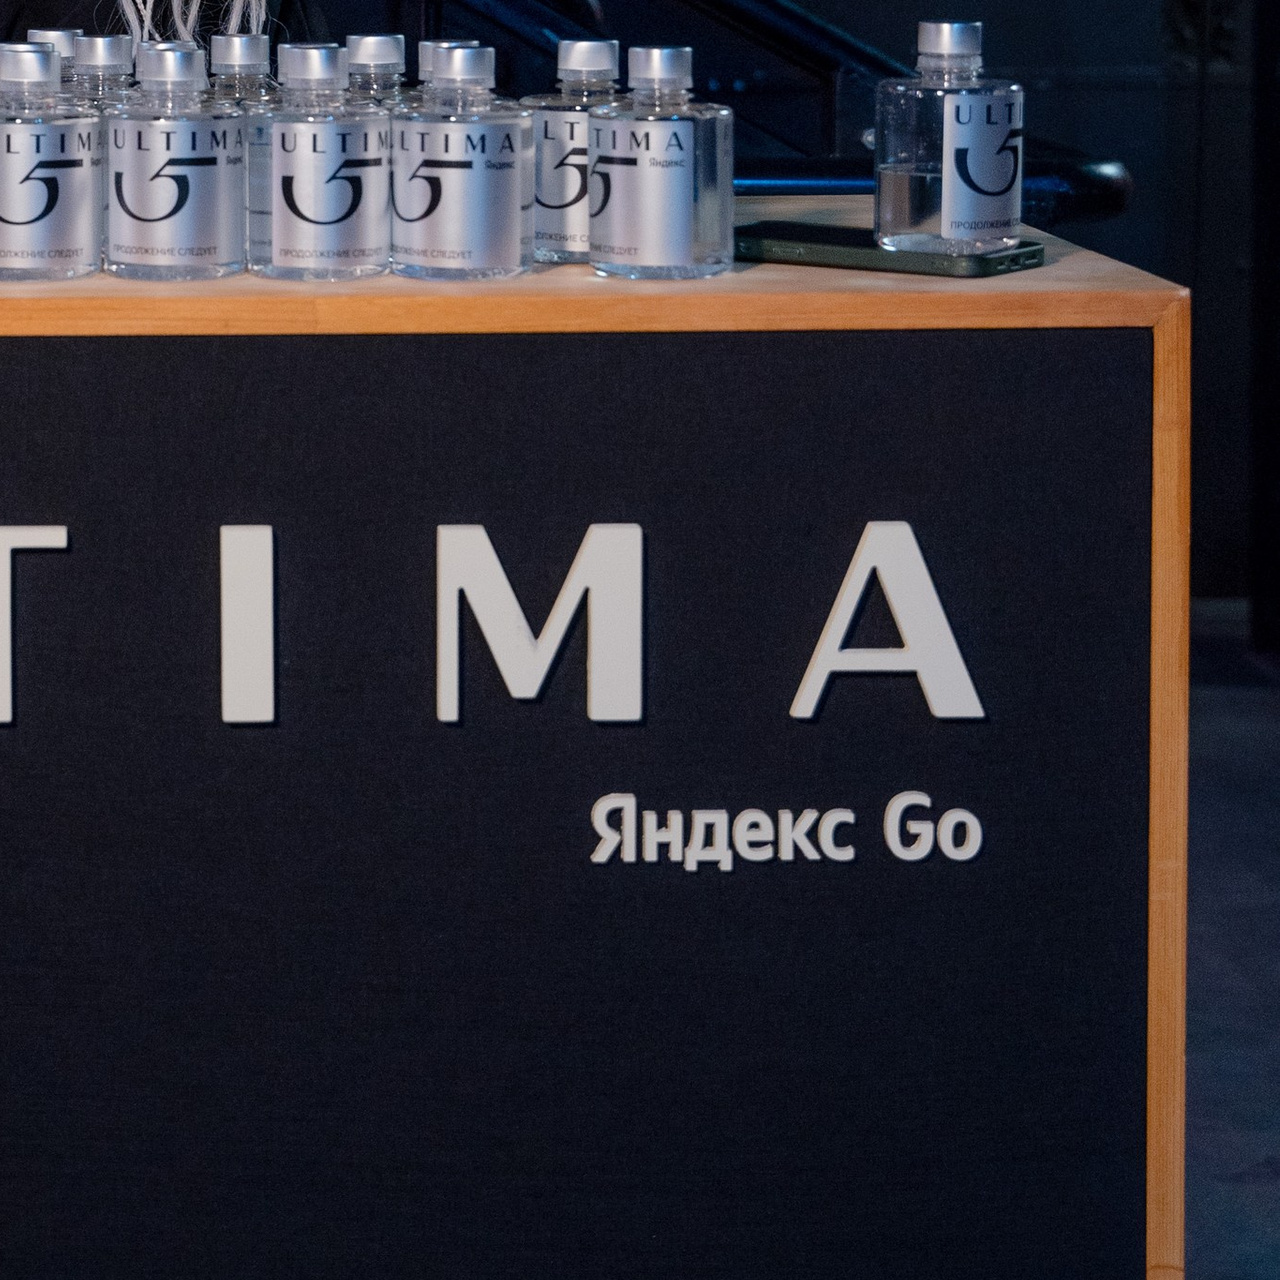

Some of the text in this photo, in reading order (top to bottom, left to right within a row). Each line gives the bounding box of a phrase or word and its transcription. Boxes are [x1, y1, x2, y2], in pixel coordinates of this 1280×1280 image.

[114, 128, 243, 151] ULTIMA
[590, 790, 983, 871] Яндекс Go
